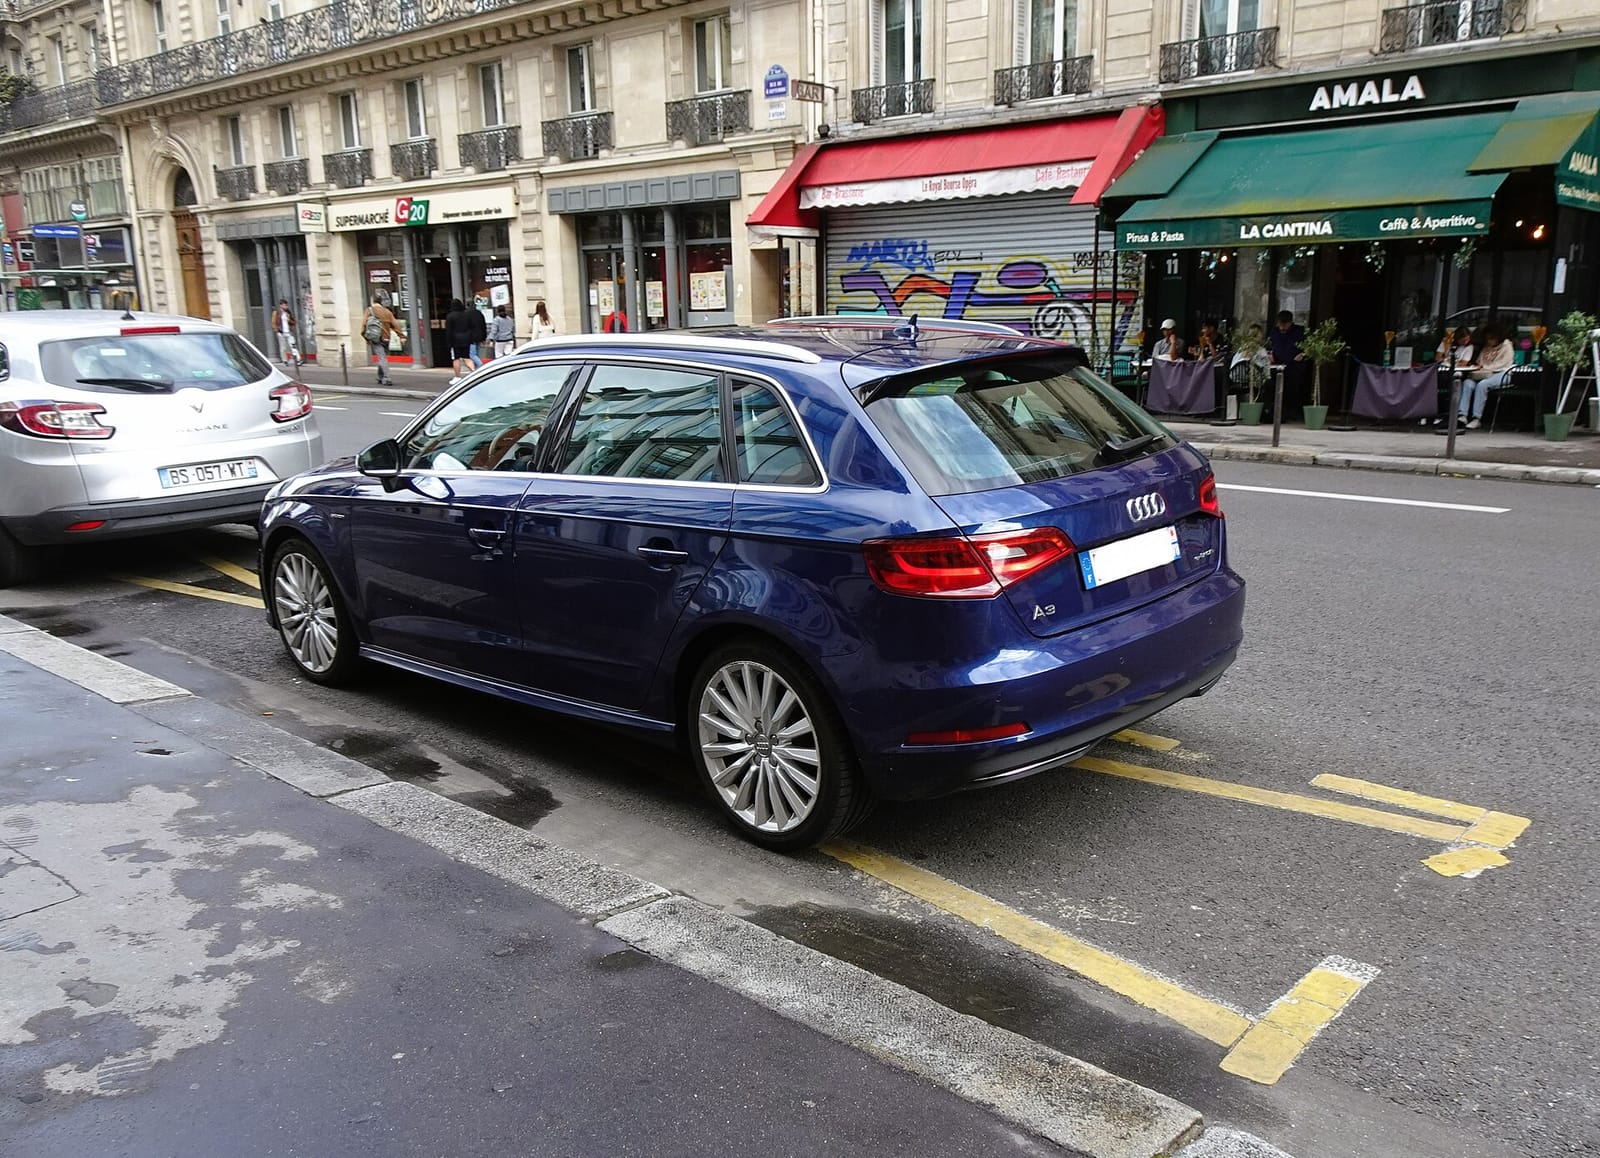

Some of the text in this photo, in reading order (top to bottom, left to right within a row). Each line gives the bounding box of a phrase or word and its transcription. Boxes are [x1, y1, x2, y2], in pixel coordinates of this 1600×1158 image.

[798, 84, 820, 100] BAR
[1309, 75, 1425, 111] AMALA
[1568, 151, 1599, 176] AMALA
[922, 176, 977, 195] Le Royal Bourse Opéra
[335, 208, 389, 227] SUPERMARCHÉ
[1379, 214, 1476, 231] Caffè & Aperitivo
[1126, 231, 1184, 243] Pinsa & Pasta
[1240, 220, 1333, 239] LA CANTINA
[1166, 258, 1179, 275] 11
[1033, 603, 1056, 621] A3
